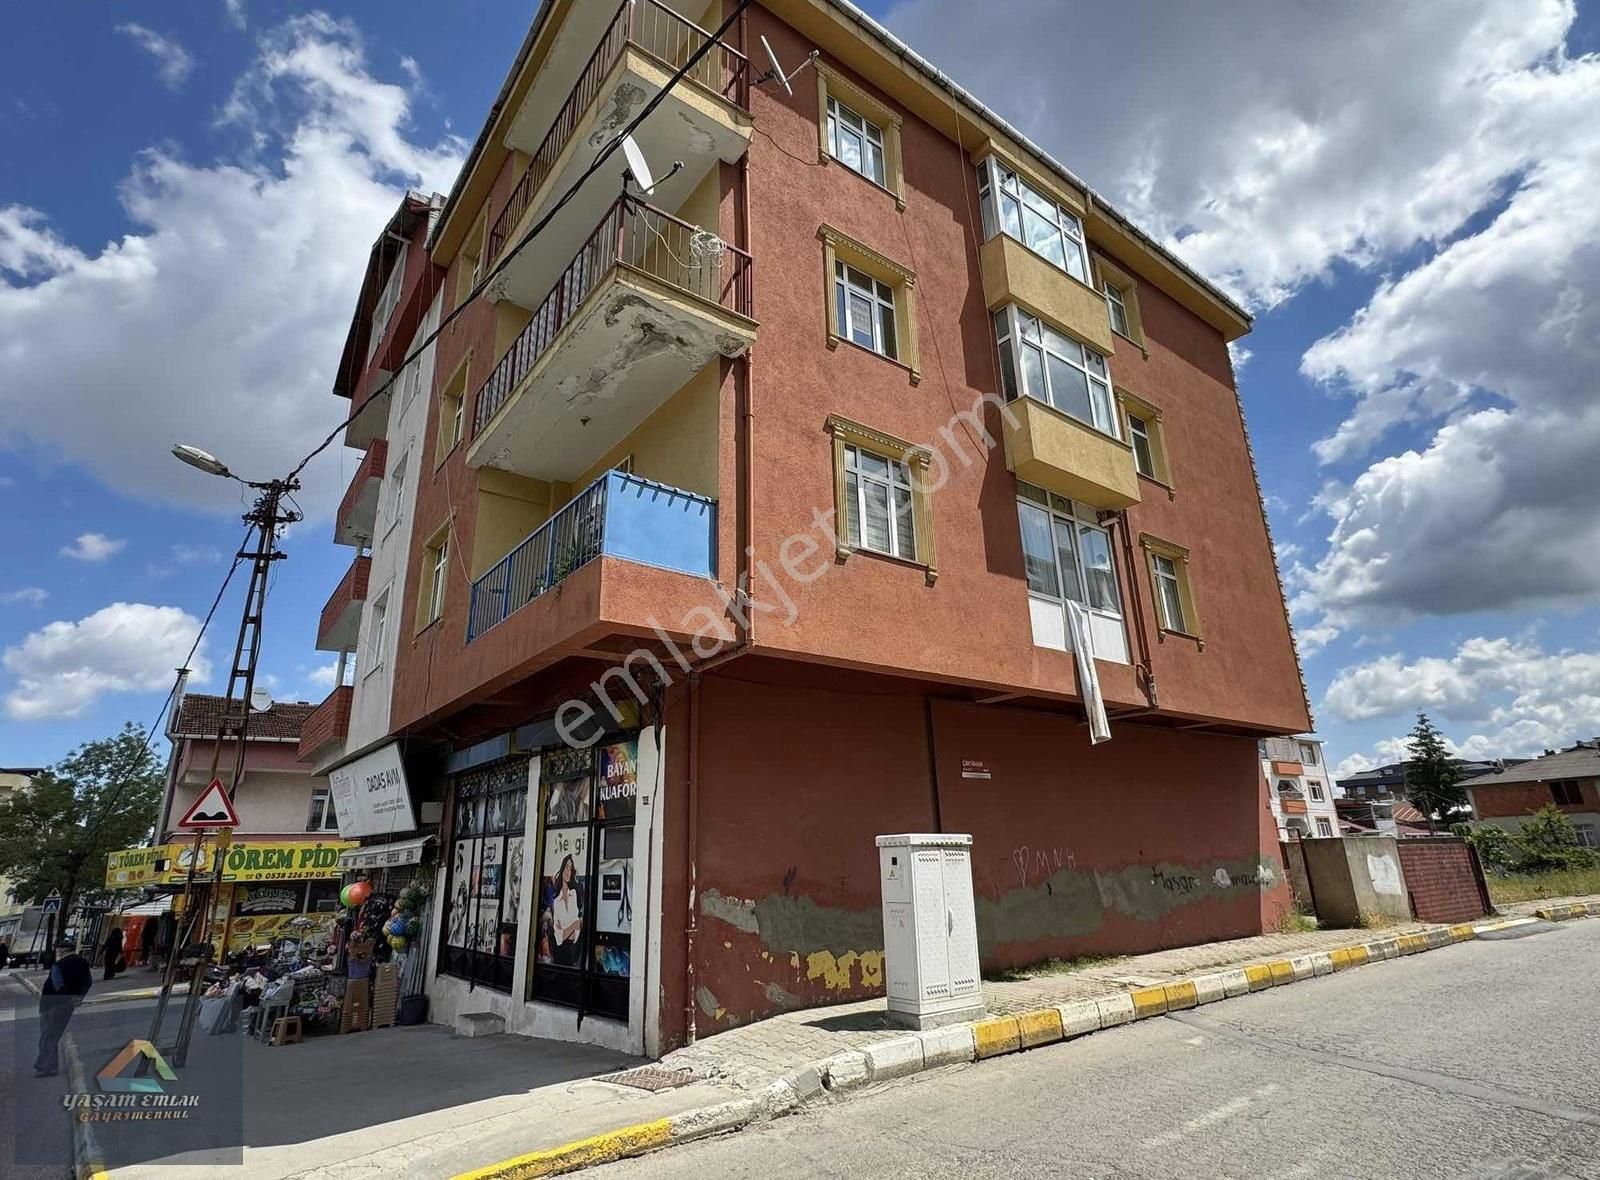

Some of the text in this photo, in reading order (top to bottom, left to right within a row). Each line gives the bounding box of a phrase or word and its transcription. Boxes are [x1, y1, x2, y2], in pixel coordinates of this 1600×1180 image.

[607, 760, 637, 778] BAYAN
[600, 780, 637, 801] KUAFÖR
[119, 851, 145, 868] TÖREM
[287, 871, 302, 879] 226
